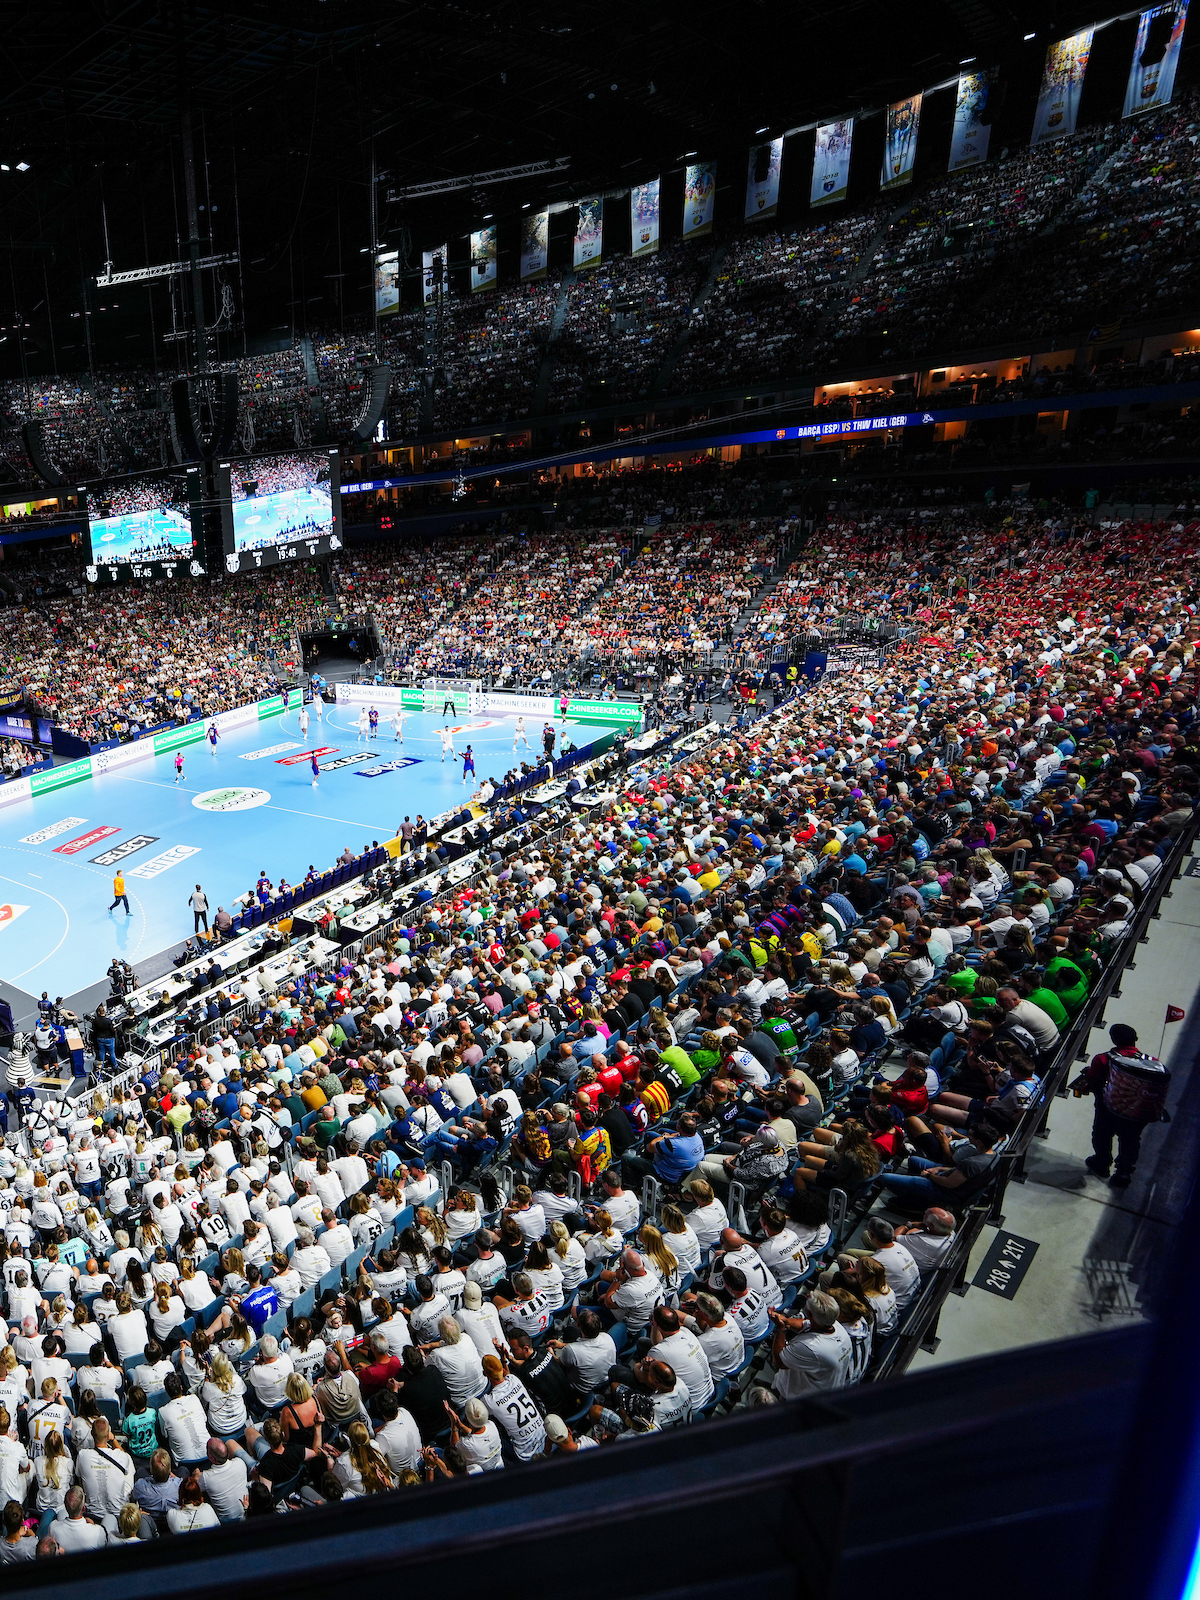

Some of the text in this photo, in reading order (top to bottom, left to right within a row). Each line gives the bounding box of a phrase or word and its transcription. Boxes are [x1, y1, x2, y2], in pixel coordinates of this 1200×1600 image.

[798, 416, 907, 437] BARÇA (ESP) VS THW KIEL (GER)
[278, 548, 297, 560] 19:45
[310, 545, 316, 555] 6
[256, 557, 261, 567] 9
[112, 571, 117, 581] 9
[132, 568, 152, 578] 19:45
[166, 568, 173, 578] 6
[352, 689, 395, 697] MACHINESEEKER
[491, 699, 546, 709] MACHINESEEKER
[556, 703, 639, 716] MCHINESEEKER.COM
[155, 725, 204, 747] MACHINESEEKER.COM
[109, 743, 149, 760] MACHINESEEKER
[32, 763, 90, 787] MACHINESEEKER.COM
[202, 789, 242, 805] Truck
[94, 836, 155, 865] SELECT
[133, 847, 195, 877] HEITEC
[496, 946, 505, 958] 10
[667, 1071, 682, 1087] 15
[86, 1162, 93, 1171] 4
[140, 1162, 145, 1172] 6
[313, 1207, 322, 1221] 8
[207, 1217, 225, 1234] 10
[369, 1224, 383, 1240] 53
[100, 1231, 108, 1243] 4
[1002, 1238, 1026, 1260] 217
[64, 1254, 76, 1264] 17
[753, 1263, 768, 1287] 7
[986, 1268, 1011, 1290] 218
[496, 1383, 522, 1407] PROVINZIAL
[507, 1394, 538, 1428] 25
[33, 1419, 57, 1441] 17
[138, 1429, 152, 1444] 23
